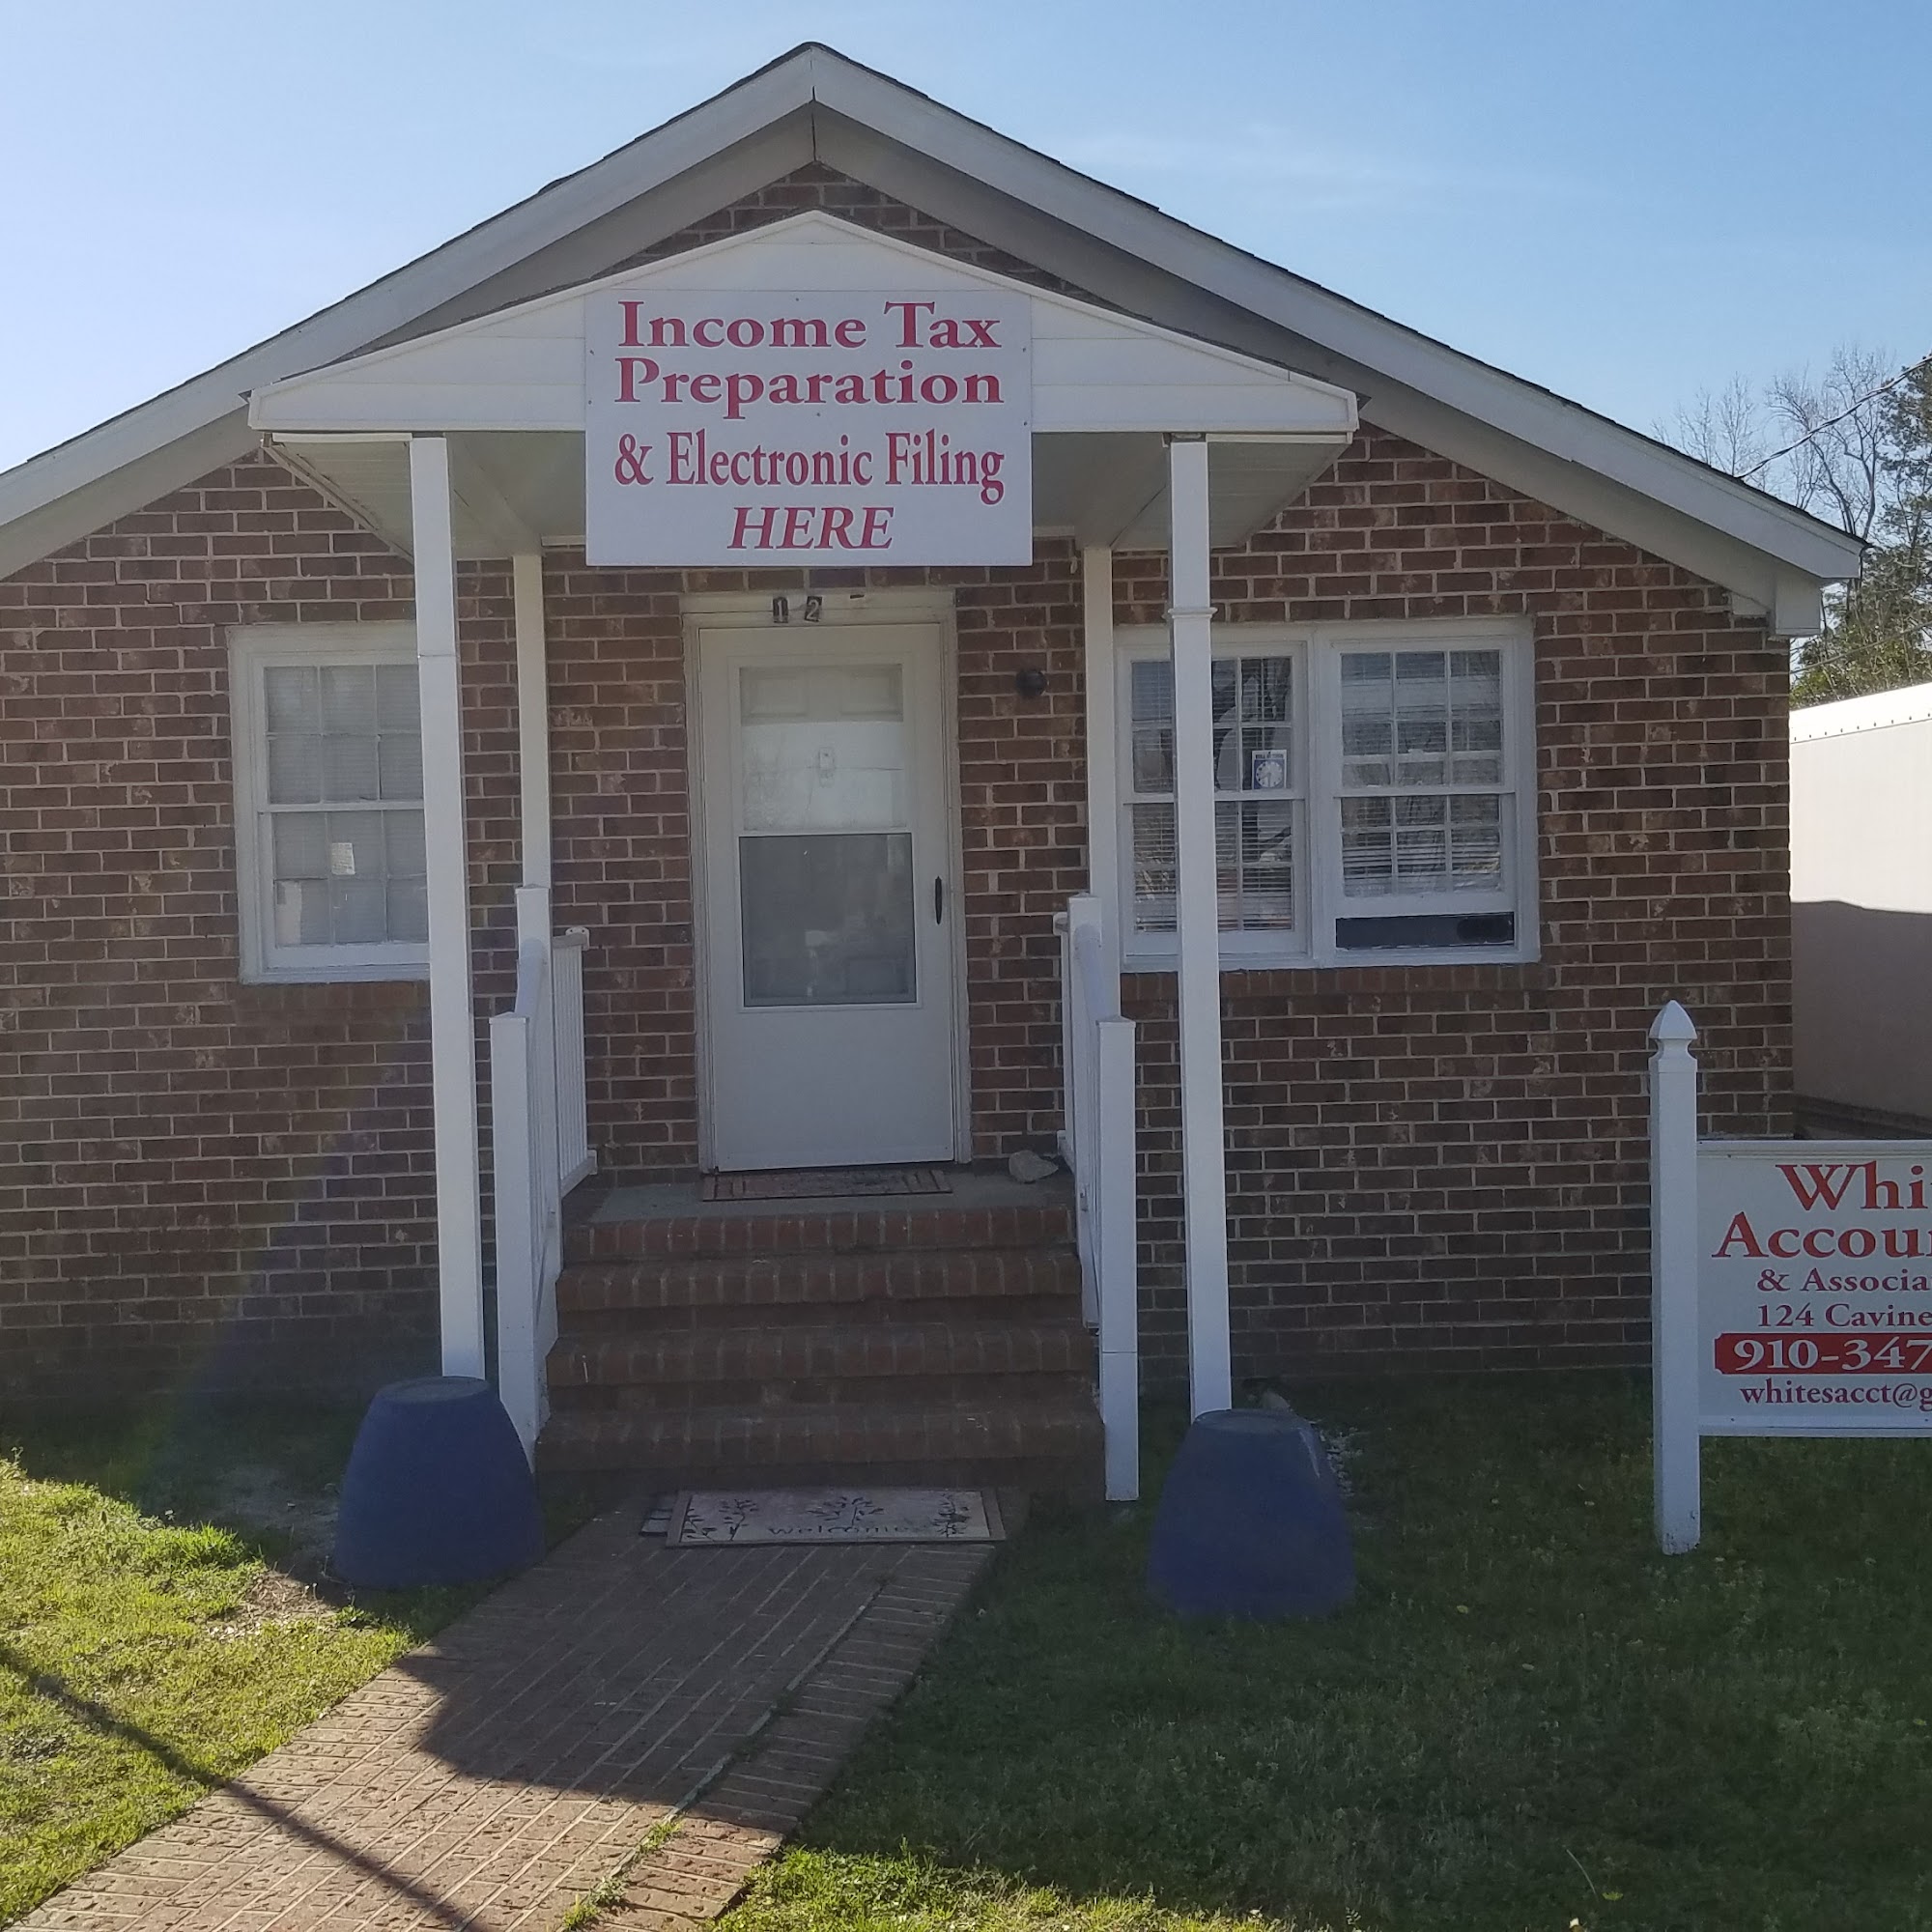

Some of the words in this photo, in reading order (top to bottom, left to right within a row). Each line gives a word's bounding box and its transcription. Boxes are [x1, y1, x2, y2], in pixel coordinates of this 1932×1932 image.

[617, 300, 867, 348] Income
[883, 301, 1002, 349] Tax
[613, 357, 1005, 420] Preparation
[614, 433, 654, 486] &
[666, 428, 873, 486] Electronic
[885, 428, 1006, 505] Filing
[726, 506, 895, 551] HERE
[1775, 1160, 1932, 1211] Whi
[1711, 1210, 1932, 1259] Accou
[1756, 1267, 1790, 1293] &
[1757, 1302, 1814, 1327] 124
